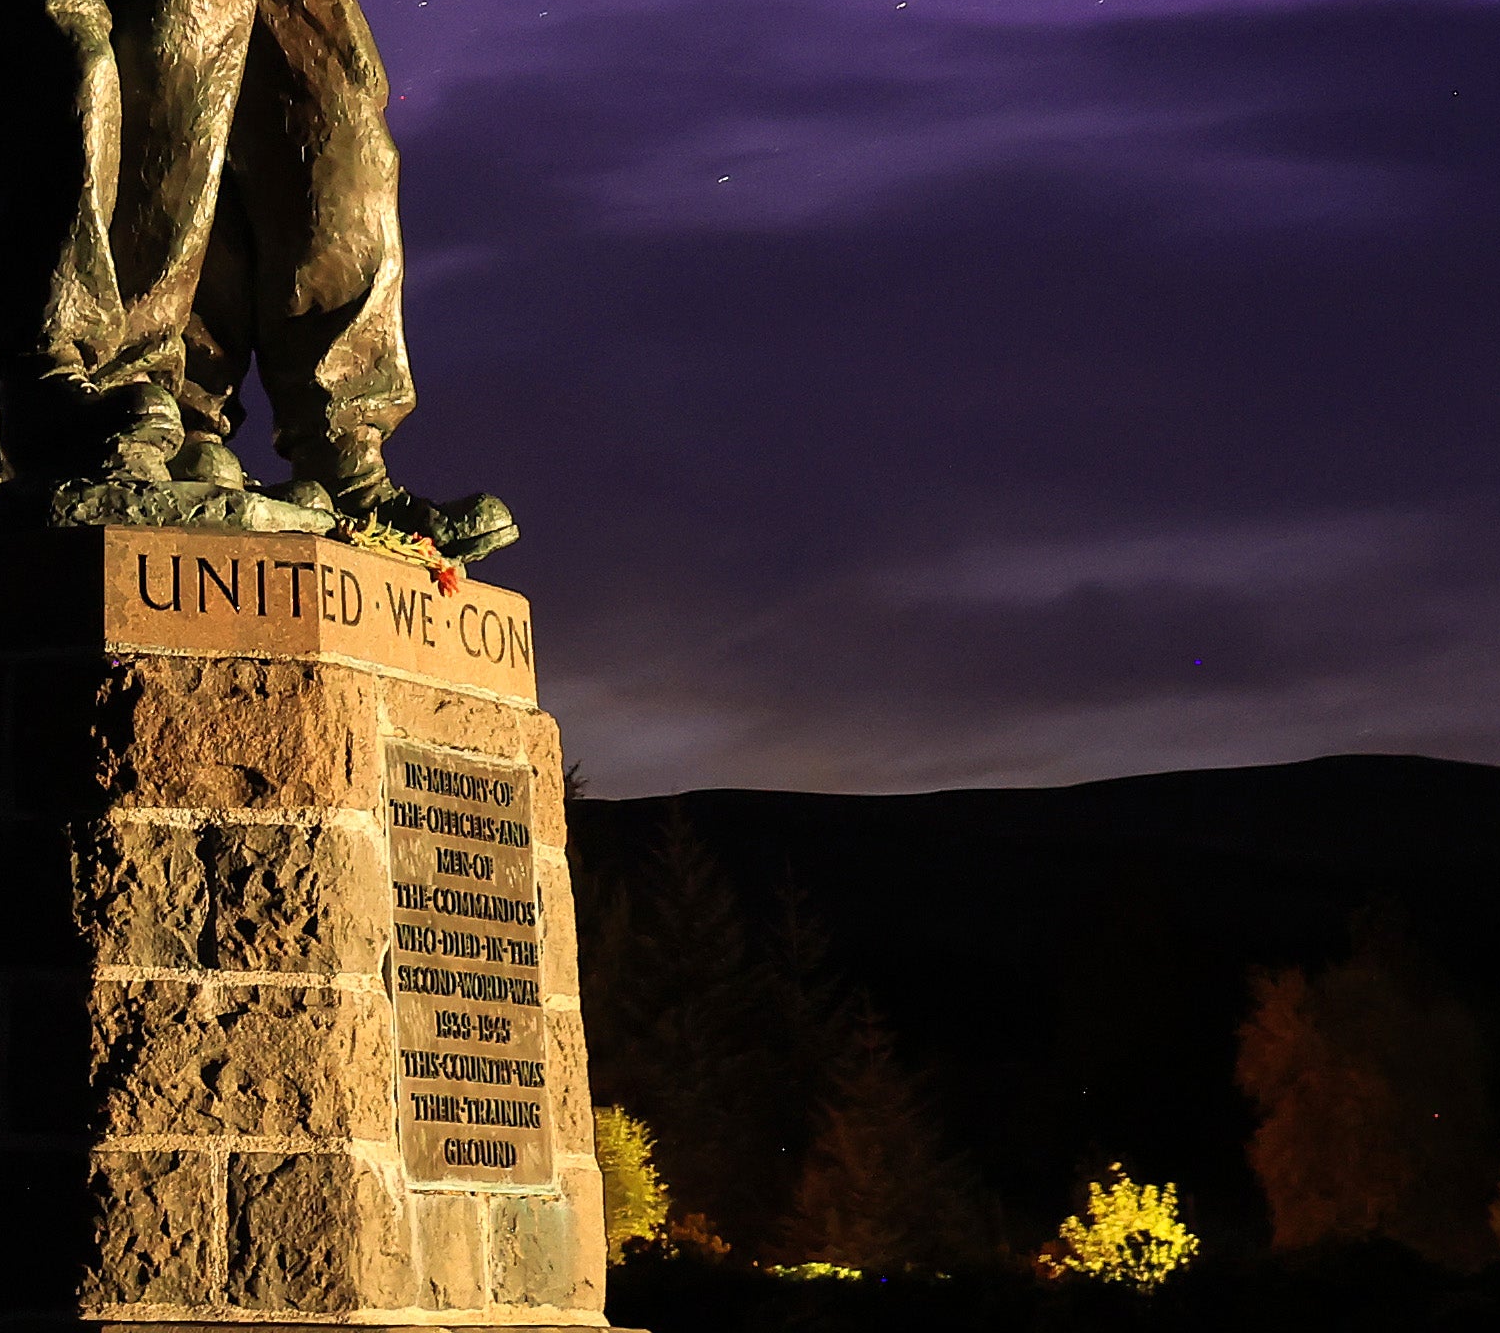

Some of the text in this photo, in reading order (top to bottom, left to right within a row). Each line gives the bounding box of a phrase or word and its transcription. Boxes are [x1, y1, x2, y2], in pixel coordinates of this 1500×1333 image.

[137, 553, 362, 627] UNITED
[384, 581, 436, 647] WE
[405, 761, 514, 807] IN MEMORY OF
[389, 798, 530, 848] THE OFFICERS AND
[435, 847, 494, 881] MEN OF
[393, 881, 536, 927] THE COMMANDOS
[394, 922, 539, 967] WHO DIED IN THE
[398, 964, 541, 1007] SECOND WORLD WAR
[401, 1049, 545, 1088] THIS COUNTRY WAS
[411, 1092, 541, 1129] THEIR TRAINING
[444, 1137, 516, 1169] GROUND
